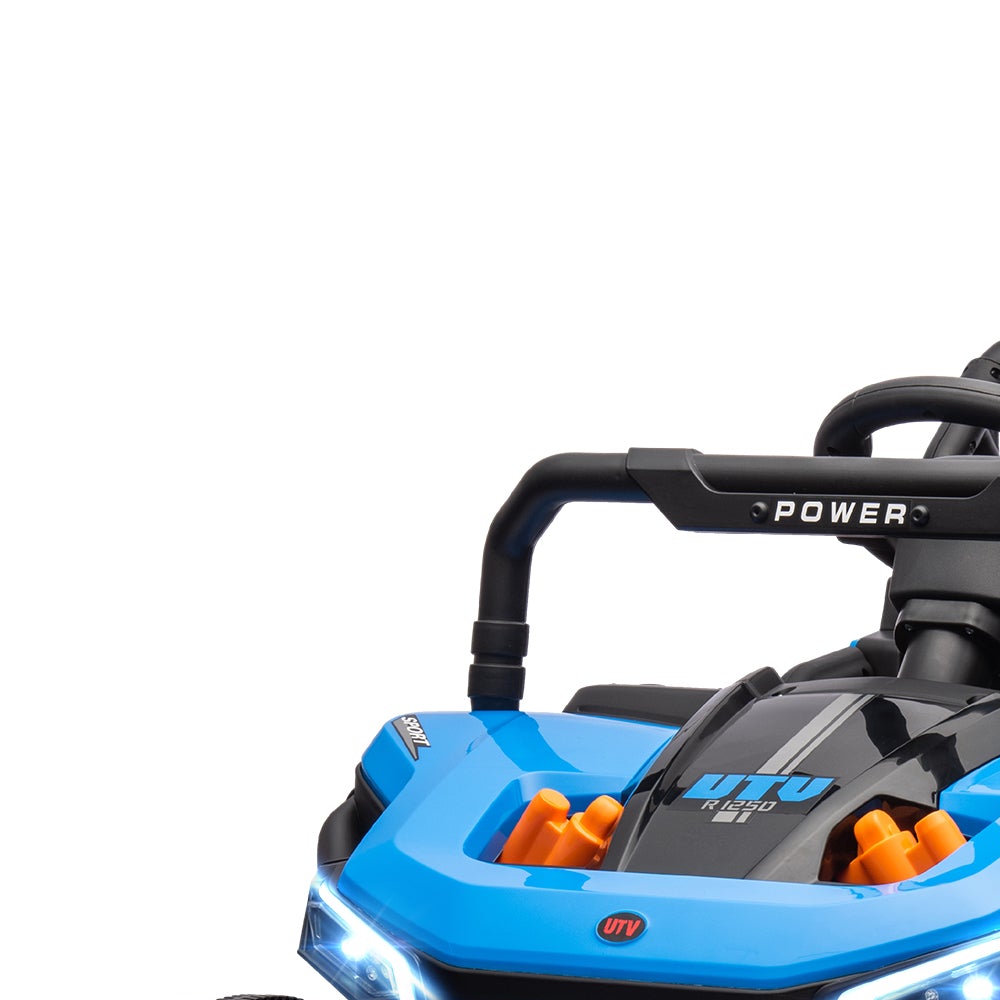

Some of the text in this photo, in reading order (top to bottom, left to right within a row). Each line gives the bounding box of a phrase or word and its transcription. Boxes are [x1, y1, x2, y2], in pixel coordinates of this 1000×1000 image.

[774, 501, 907, 525] POWER
[401, 716, 431, 746] SPORT
[603, 917, 641, 937] UTV
